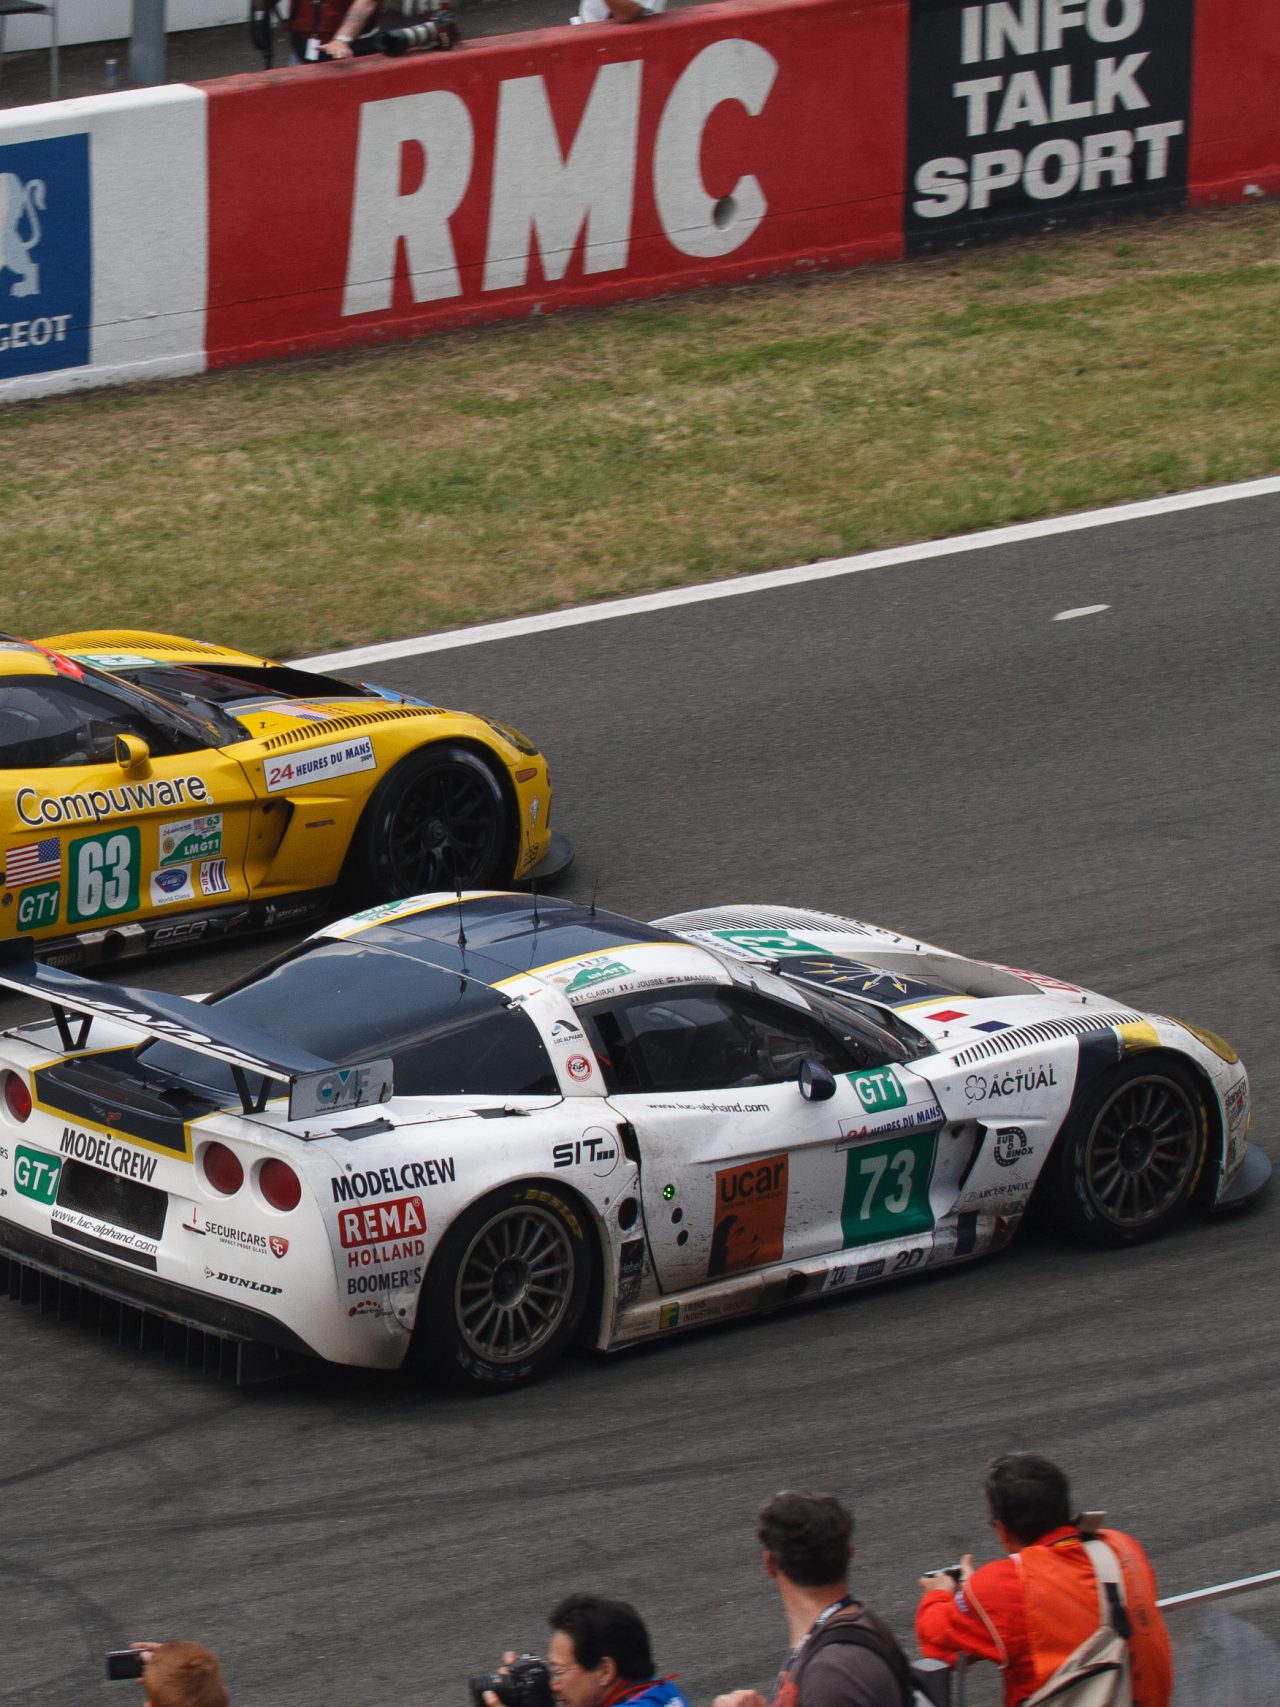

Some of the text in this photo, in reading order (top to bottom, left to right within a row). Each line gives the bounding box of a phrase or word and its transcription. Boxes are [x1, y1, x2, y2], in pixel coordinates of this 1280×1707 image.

[959, 0, 1145, 64] INFO
[952, 51, 1152, 137] TALK
[341, 38, 779, 317] RMC
[912, 120, 1185, 218] SPORT
[269, 742, 371, 785] 24 HEURES DU MANS
[16, 775, 207, 825] Compuware
[207, 815, 220, 826] 63
[77, 835, 131, 916] 63
[20, 889, 60, 923] GT1
[637, 978, 664, 989] JOUSSE
[855, 1071, 900, 1105] GT1
[988, 1068, 1057, 1099] ACTUAL
[903, 1115, 915, 1128] DU
[917, 1105, 941, 1122] MANS
[15, 1155, 60, 1196] GT1
[60, 1127, 157, 1183] MODELCREW
[331, 1157, 455, 1203] MODELCREW
[721, 1162, 784, 1203] ucar
[860, 1149, 916, 1220] 73
[51, 1208, 158, 1254] www.luc-alphand.com
[205, 1221, 267, 1248] SECURICARS
[344, 1202, 422, 1244] REMA
[348, 1239, 425, 1269] HOLLAND
[216, 1271, 283, 1295] DUNLOP
[347, 1266, 422, 1295] BOOMER'S
